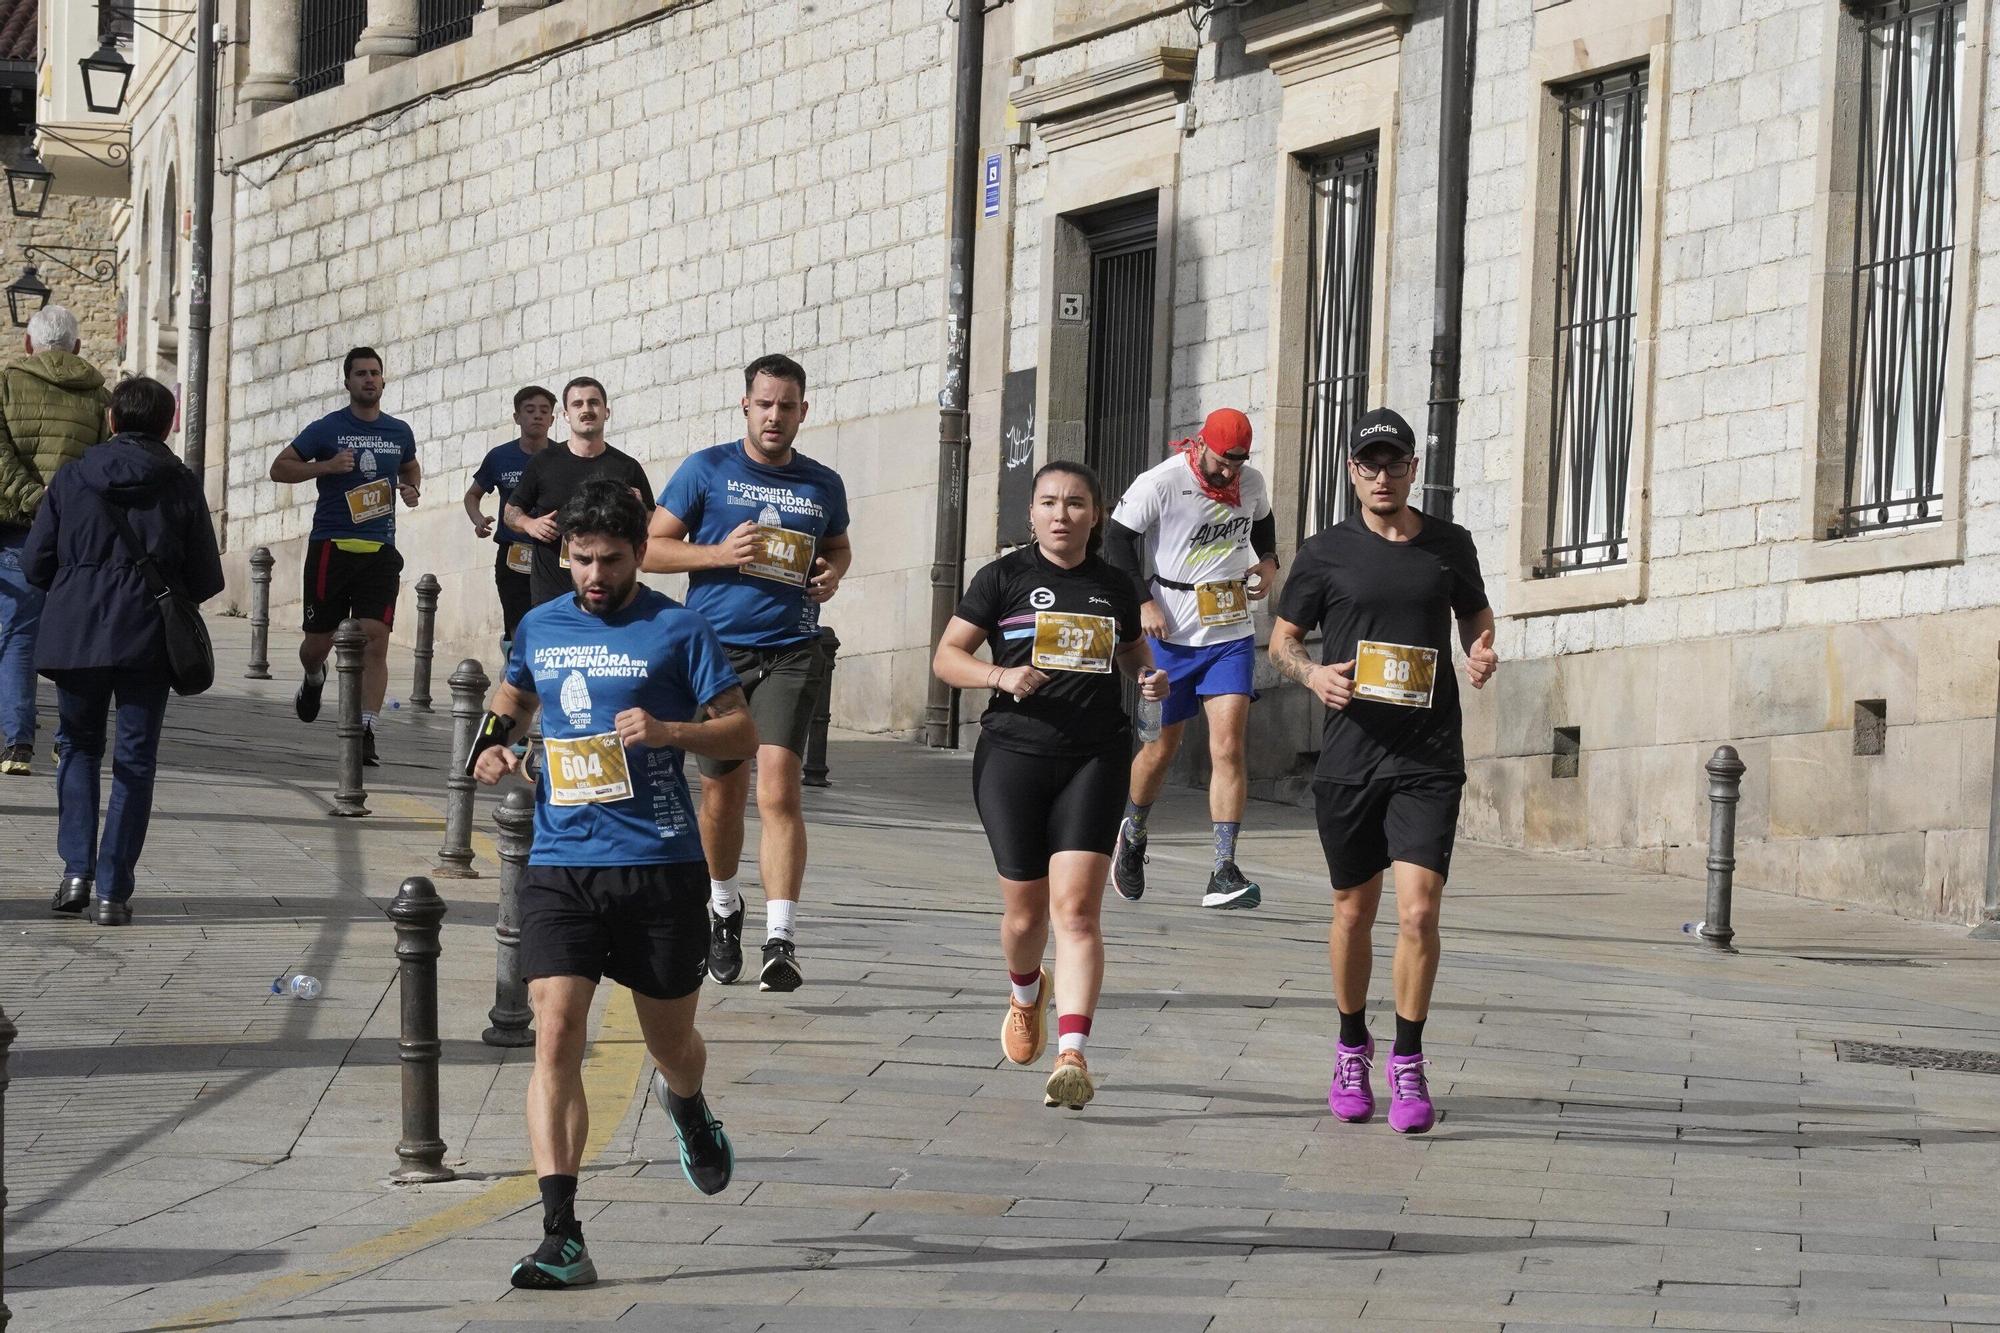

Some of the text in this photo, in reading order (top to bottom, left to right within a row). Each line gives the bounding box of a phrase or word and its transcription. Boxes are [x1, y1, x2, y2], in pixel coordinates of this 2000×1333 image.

[1360, 424, 1398, 437] Cofidis
[348, 441, 394, 449] ALMENDRA
[727, 479, 793, 497] LA CONQUISTA
[362, 490, 380, 506] 427
[742, 489, 813, 508] ALMENDRA
[780, 504, 824, 518] KONKISTA
[767, 540, 796, 564] 144
[1057, 627, 1094, 651] 337
[535, 645, 608, 658] LA CONQUISTA
[544, 653, 630, 669] ALMENDRA
[587, 667, 649, 678] KONKISTA
[1383, 659, 1410, 683] 88
[602, 738, 616, 748] 10K
[561, 752, 603, 781] 604
